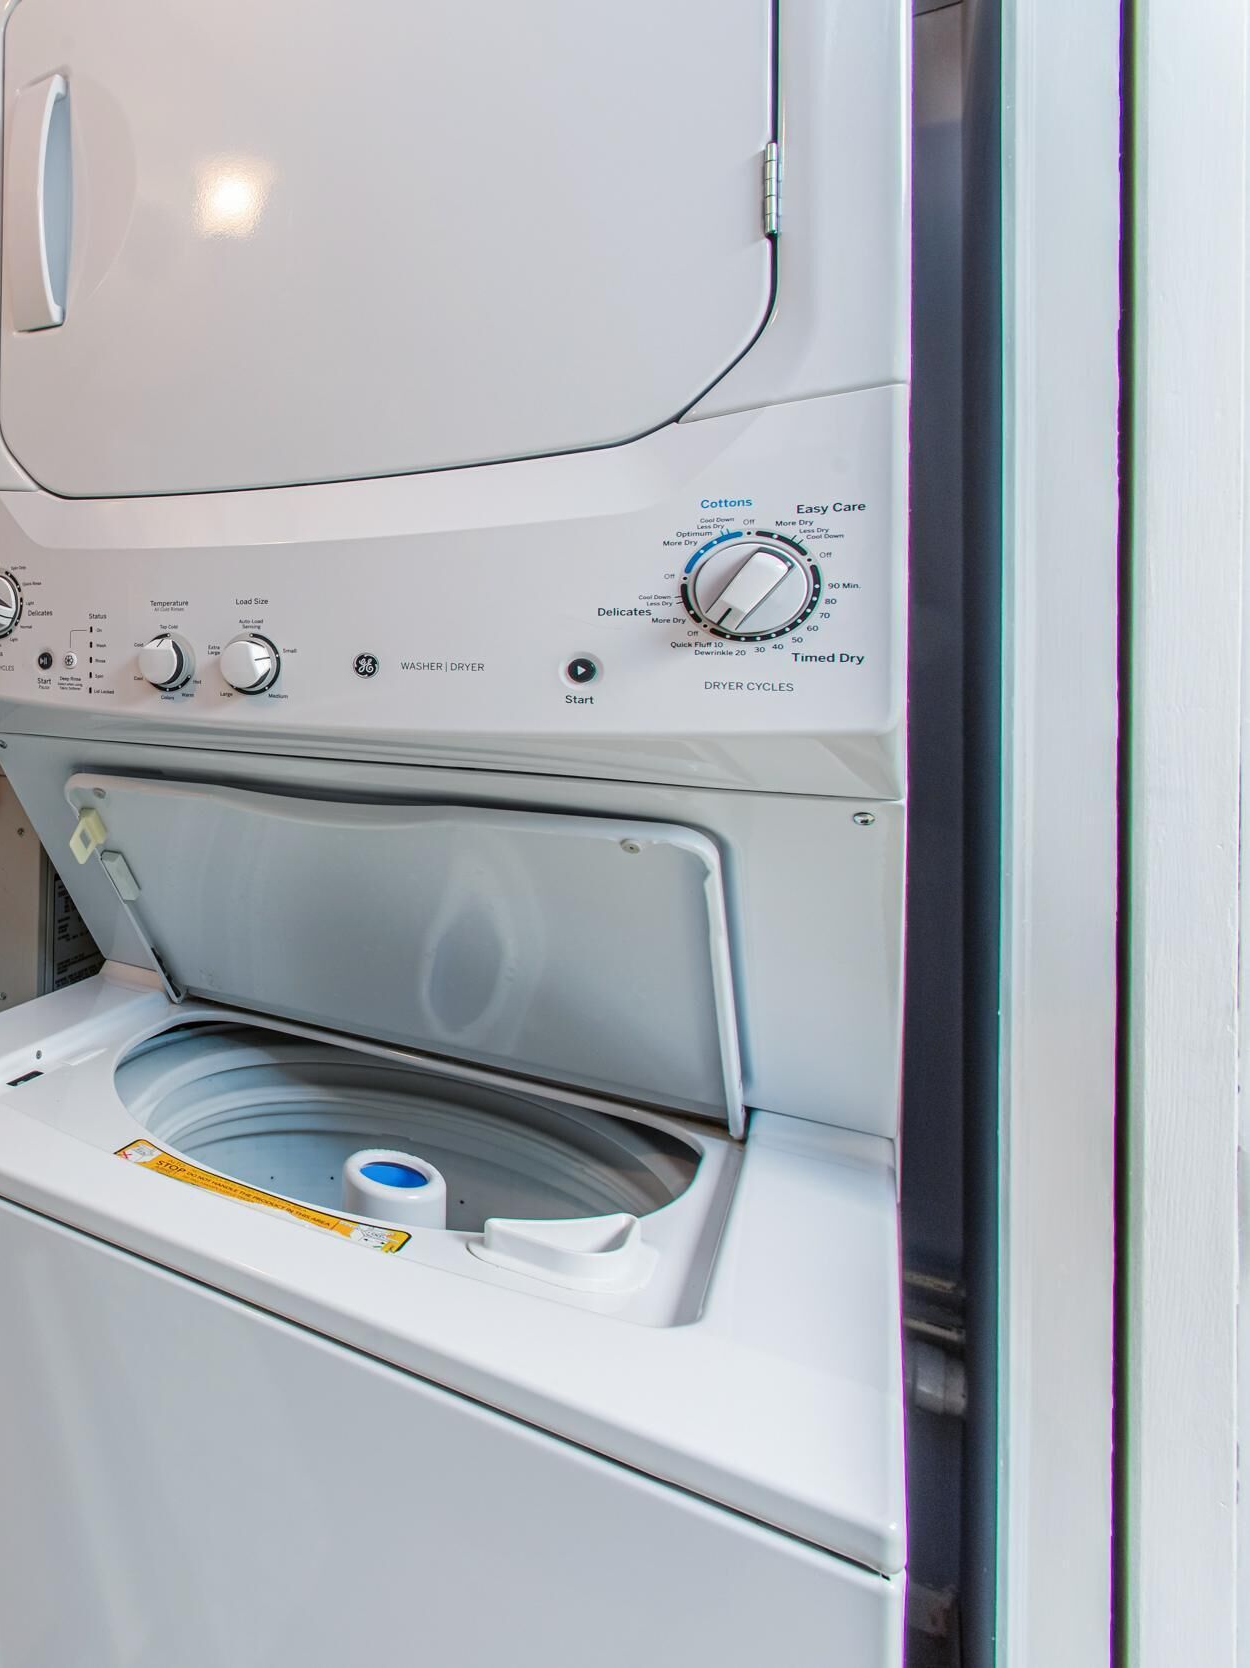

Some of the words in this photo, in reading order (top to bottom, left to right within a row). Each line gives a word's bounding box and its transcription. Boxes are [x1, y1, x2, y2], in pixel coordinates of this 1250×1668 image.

[701, 499, 752, 509] Cottons
[796, 505, 828, 515] Easy
[832, 502, 866, 512] Care
[150, 600, 189, 608] Temperature
[597, 607, 652, 617] Delicates
[791, 652, 835, 663] Timed
[839, 653, 865, 665] Dry
[400, 661, 443, 671] WASHER
[450, 662, 484, 672] DRYER
[704, 681, 744, 691] DRYER
[746, 682, 794, 692] CYCLES
[565, 694, 594, 704] Start
[157, 1160, 186, 1173] STOP
